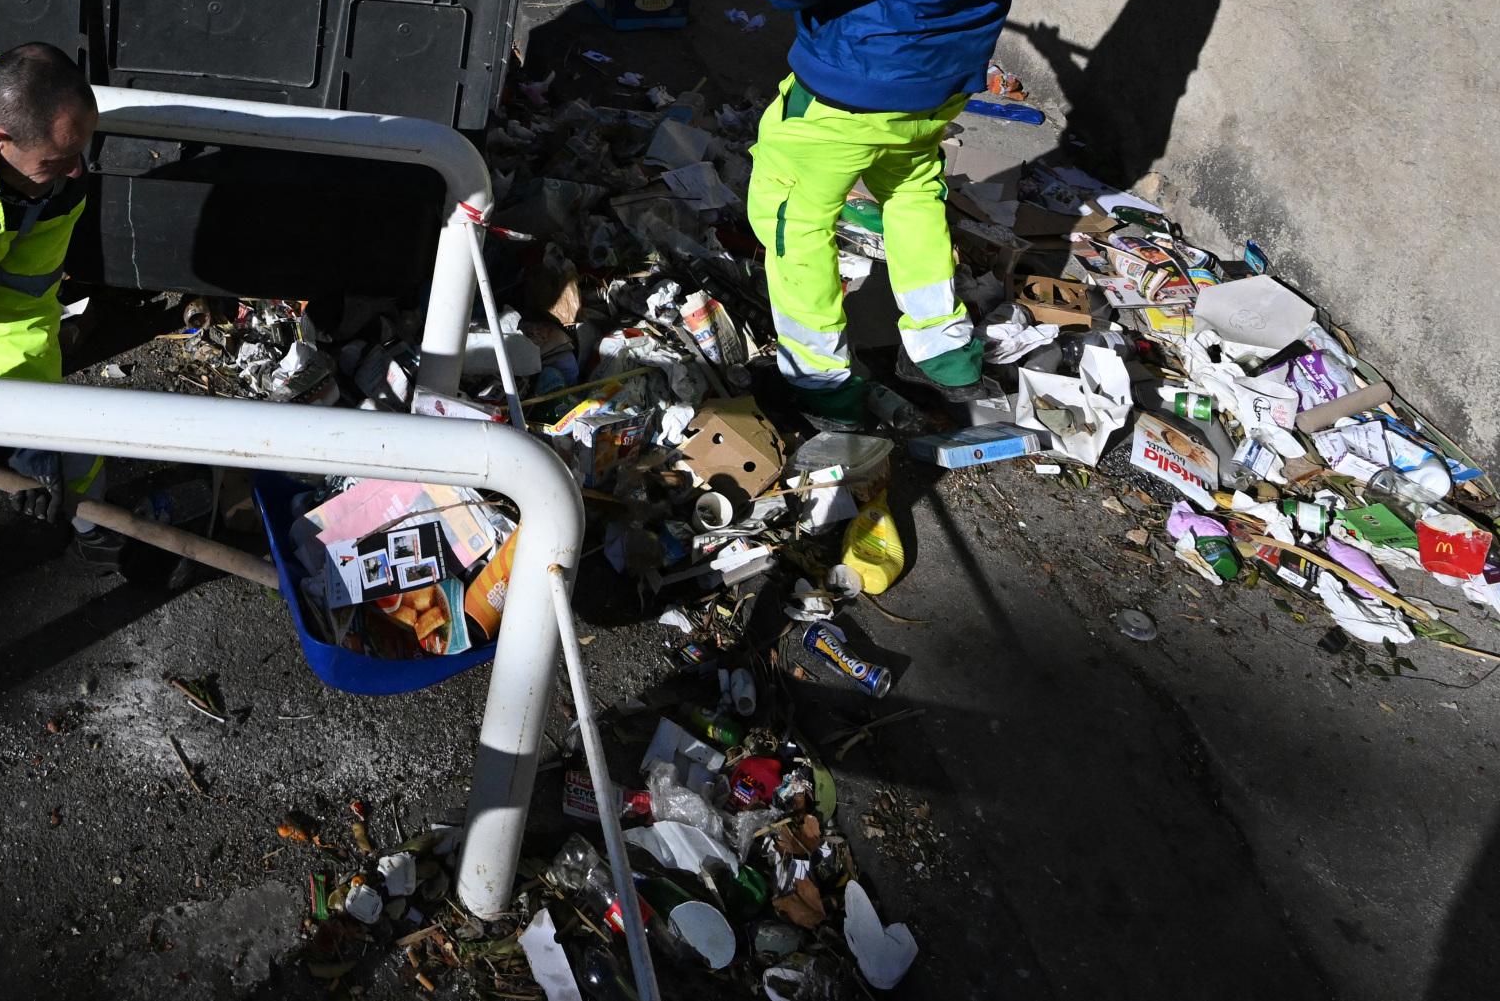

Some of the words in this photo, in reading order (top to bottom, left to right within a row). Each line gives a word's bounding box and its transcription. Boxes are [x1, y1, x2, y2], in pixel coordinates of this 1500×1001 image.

[1143, 447, 1212, 493] nutella
[1145, 440, 1187, 466] biscuits
[817, 628, 868, 679] ORANGINA
